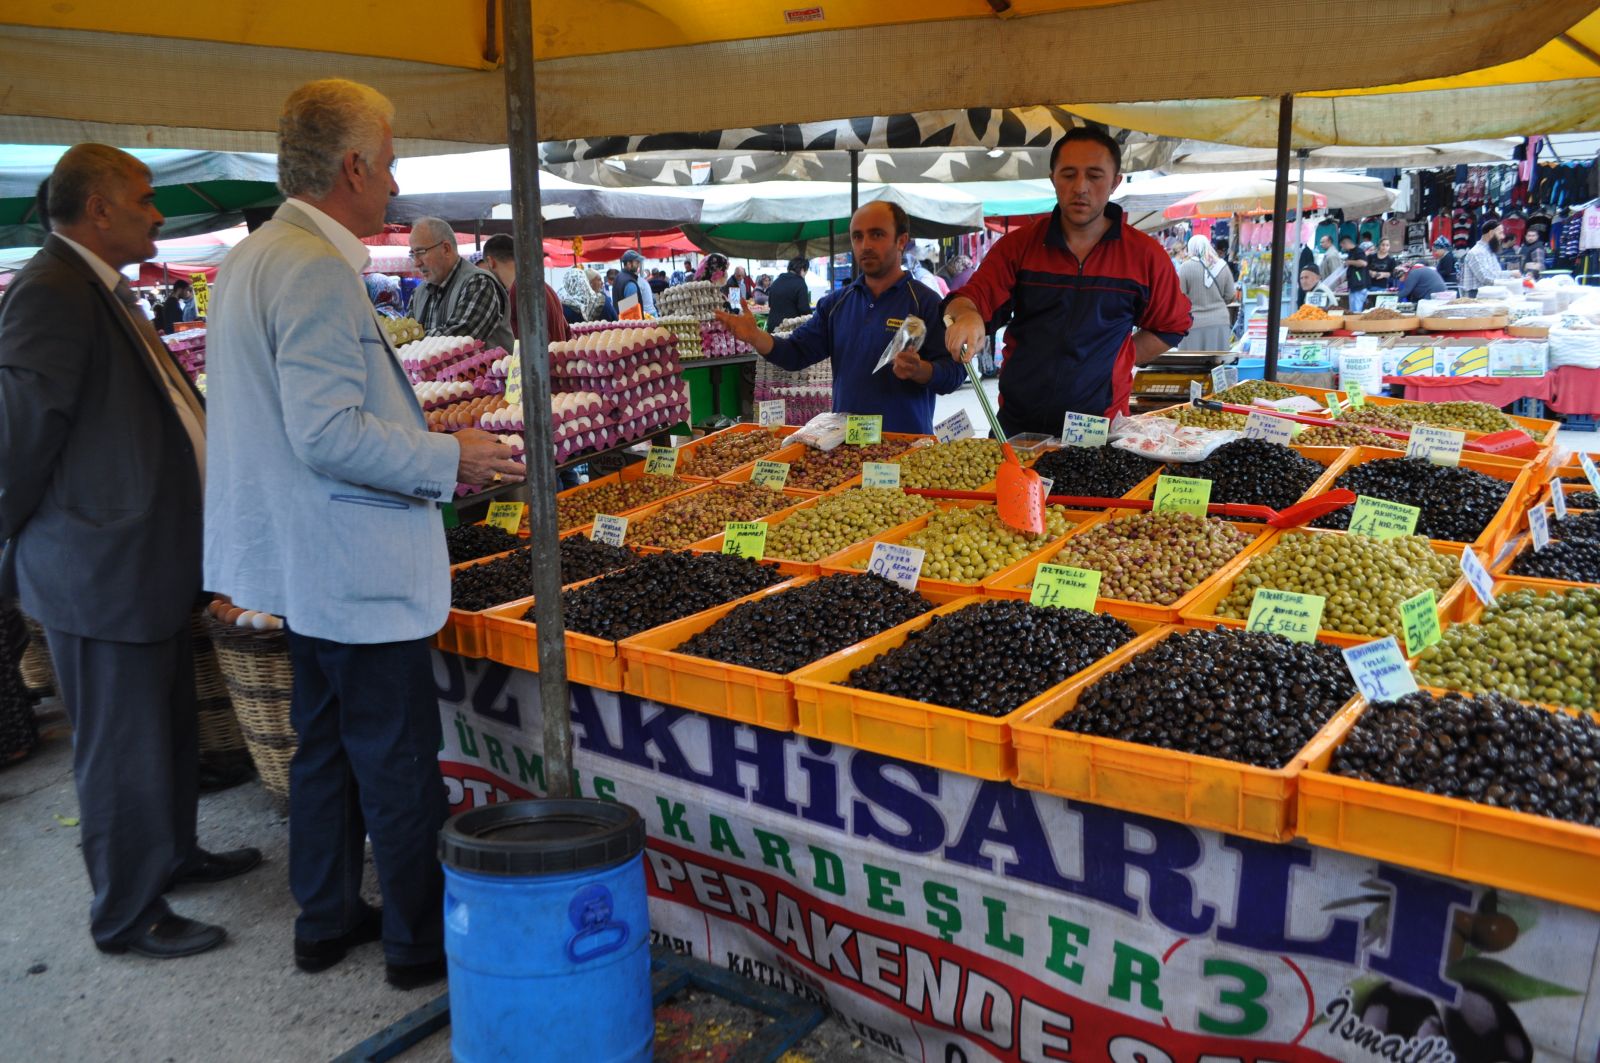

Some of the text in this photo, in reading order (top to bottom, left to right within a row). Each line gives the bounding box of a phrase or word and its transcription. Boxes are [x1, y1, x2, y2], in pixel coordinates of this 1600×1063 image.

[1277, 620, 1308, 633] SELE
[648, 847, 1075, 1063] PERAKENDE
[656, 796, 1164, 1013] KARDEŞLER
[1196, 958, 1270, 1037] 3
